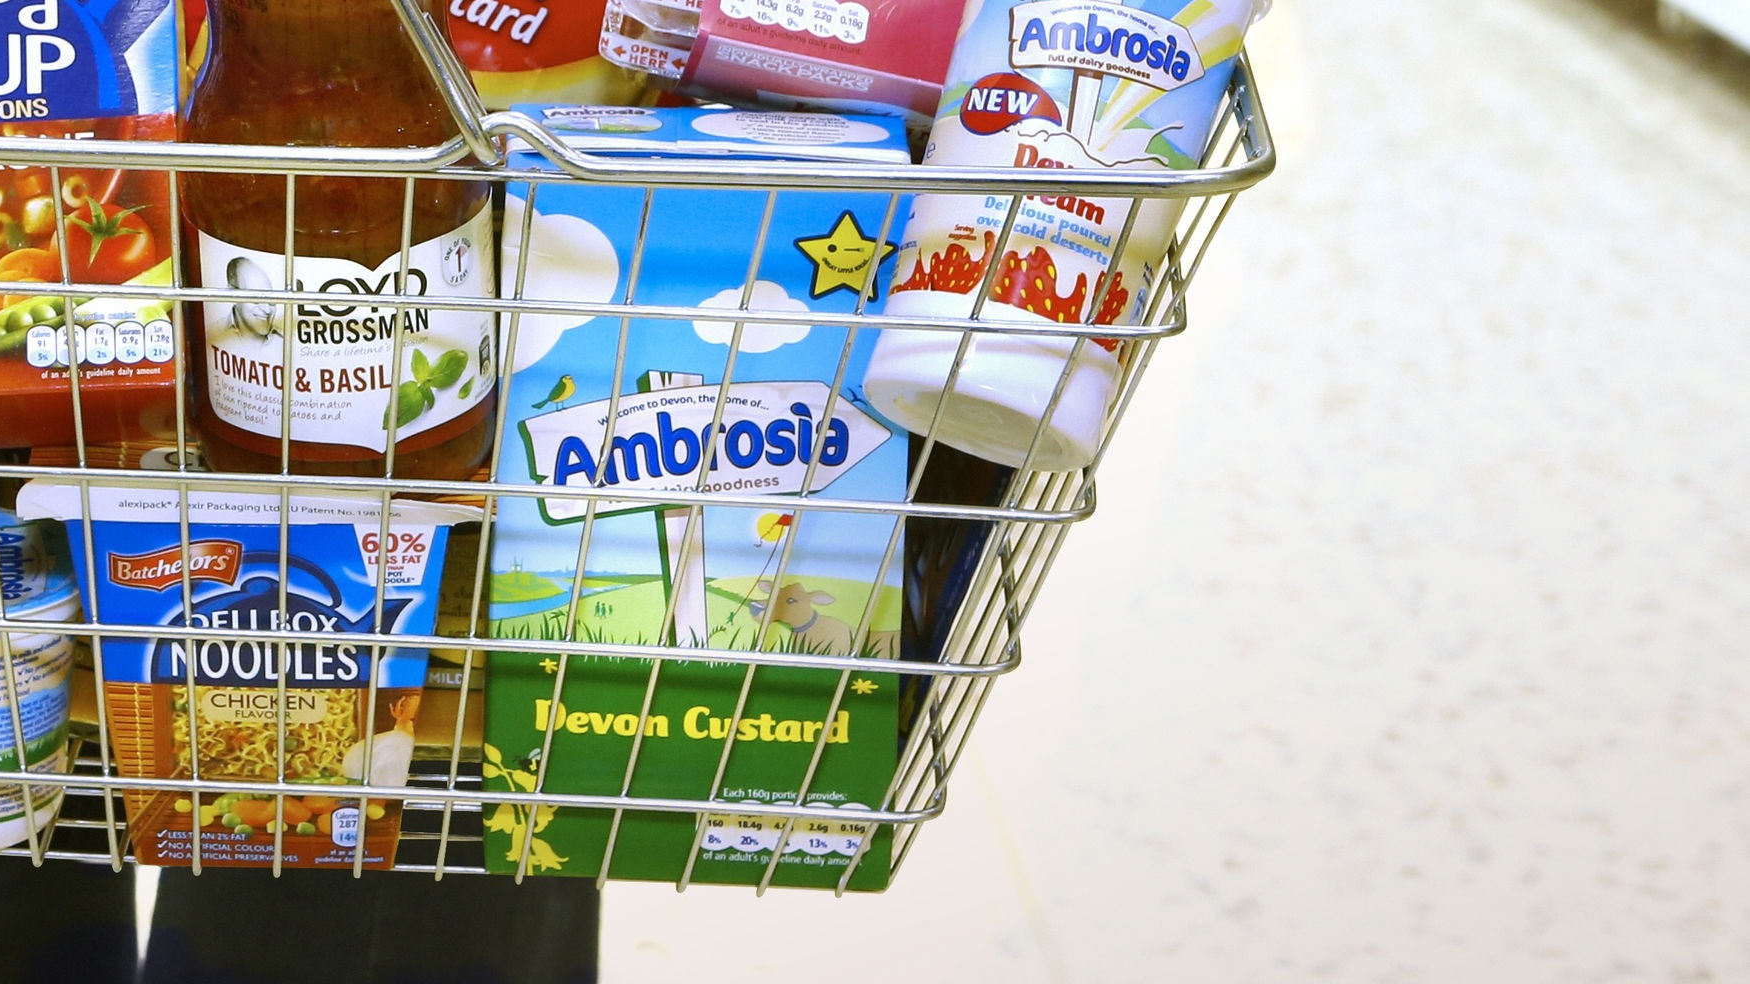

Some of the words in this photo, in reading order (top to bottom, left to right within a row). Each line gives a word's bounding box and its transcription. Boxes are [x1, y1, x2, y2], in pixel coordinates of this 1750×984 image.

[840, 15, 863, 29] 0.18g
[631, 44, 669, 60] OPEN
[1019, 13, 1191, 82] Ambrosia
[629, 54, 667, 69] HERE
[715, 50, 793, 76] SNACK
[796, 66, 870, 92] PACKS
[1067, 55, 1077, 64] of
[1079, 58, 1104, 69] dairy
[1106, 63, 1151, 80] goodness
[966, 87, 1040, 116] NEW
[984, 195, 1055, 225] Delious
[1058, 218, 1112, 248] poured
[976, 215, 1001, 228] ove
[1013, 222, 1048, 240] cold
[1050, 232, 1110, 266] desserts
[297, 309, 429, 346] GROSSMAN
[299, 346, 331, 358] Share
[211, 344, 284, 390] TOMATO
[295, 367, 312, 393] &
[321, 363, 391, 393] BASIL
[597, 403, 645, 427] Wcome
[647, 400, 658, 409] to
[660, 395, 696, 408] Devon,
[698, 394, 716, 403] the
[725, 396, 748, 406] ome
[554, 402, 849, 487] Ambrosia
[702, 476, 780, 493] goodness
[207, 502, 261, 513] Packaging
[263, 503, 280, 512] Ltd
[301, 506, 334, 516] Patent
[361, 532, 426, 554] 60%
[117, 553, 229, 581] Batcheors
[401, 554, 421, 565] FAT
[171, 641, 359, 681] NOODLES
[211, 693, 316, 710] CHICKEN
[235, 710, 291, 720] FLAVOUR
[534, 698, 669, 738] Devon
[683, 706, 850, 745] Custard
[723, 788, 745, 798] Each
[748, 789, 770, 800] 160g
[809, 823, 829, 833] 2.6g
[840, 823, 866, 833] 0.16g
[809, 838, 828, 848] 13%
